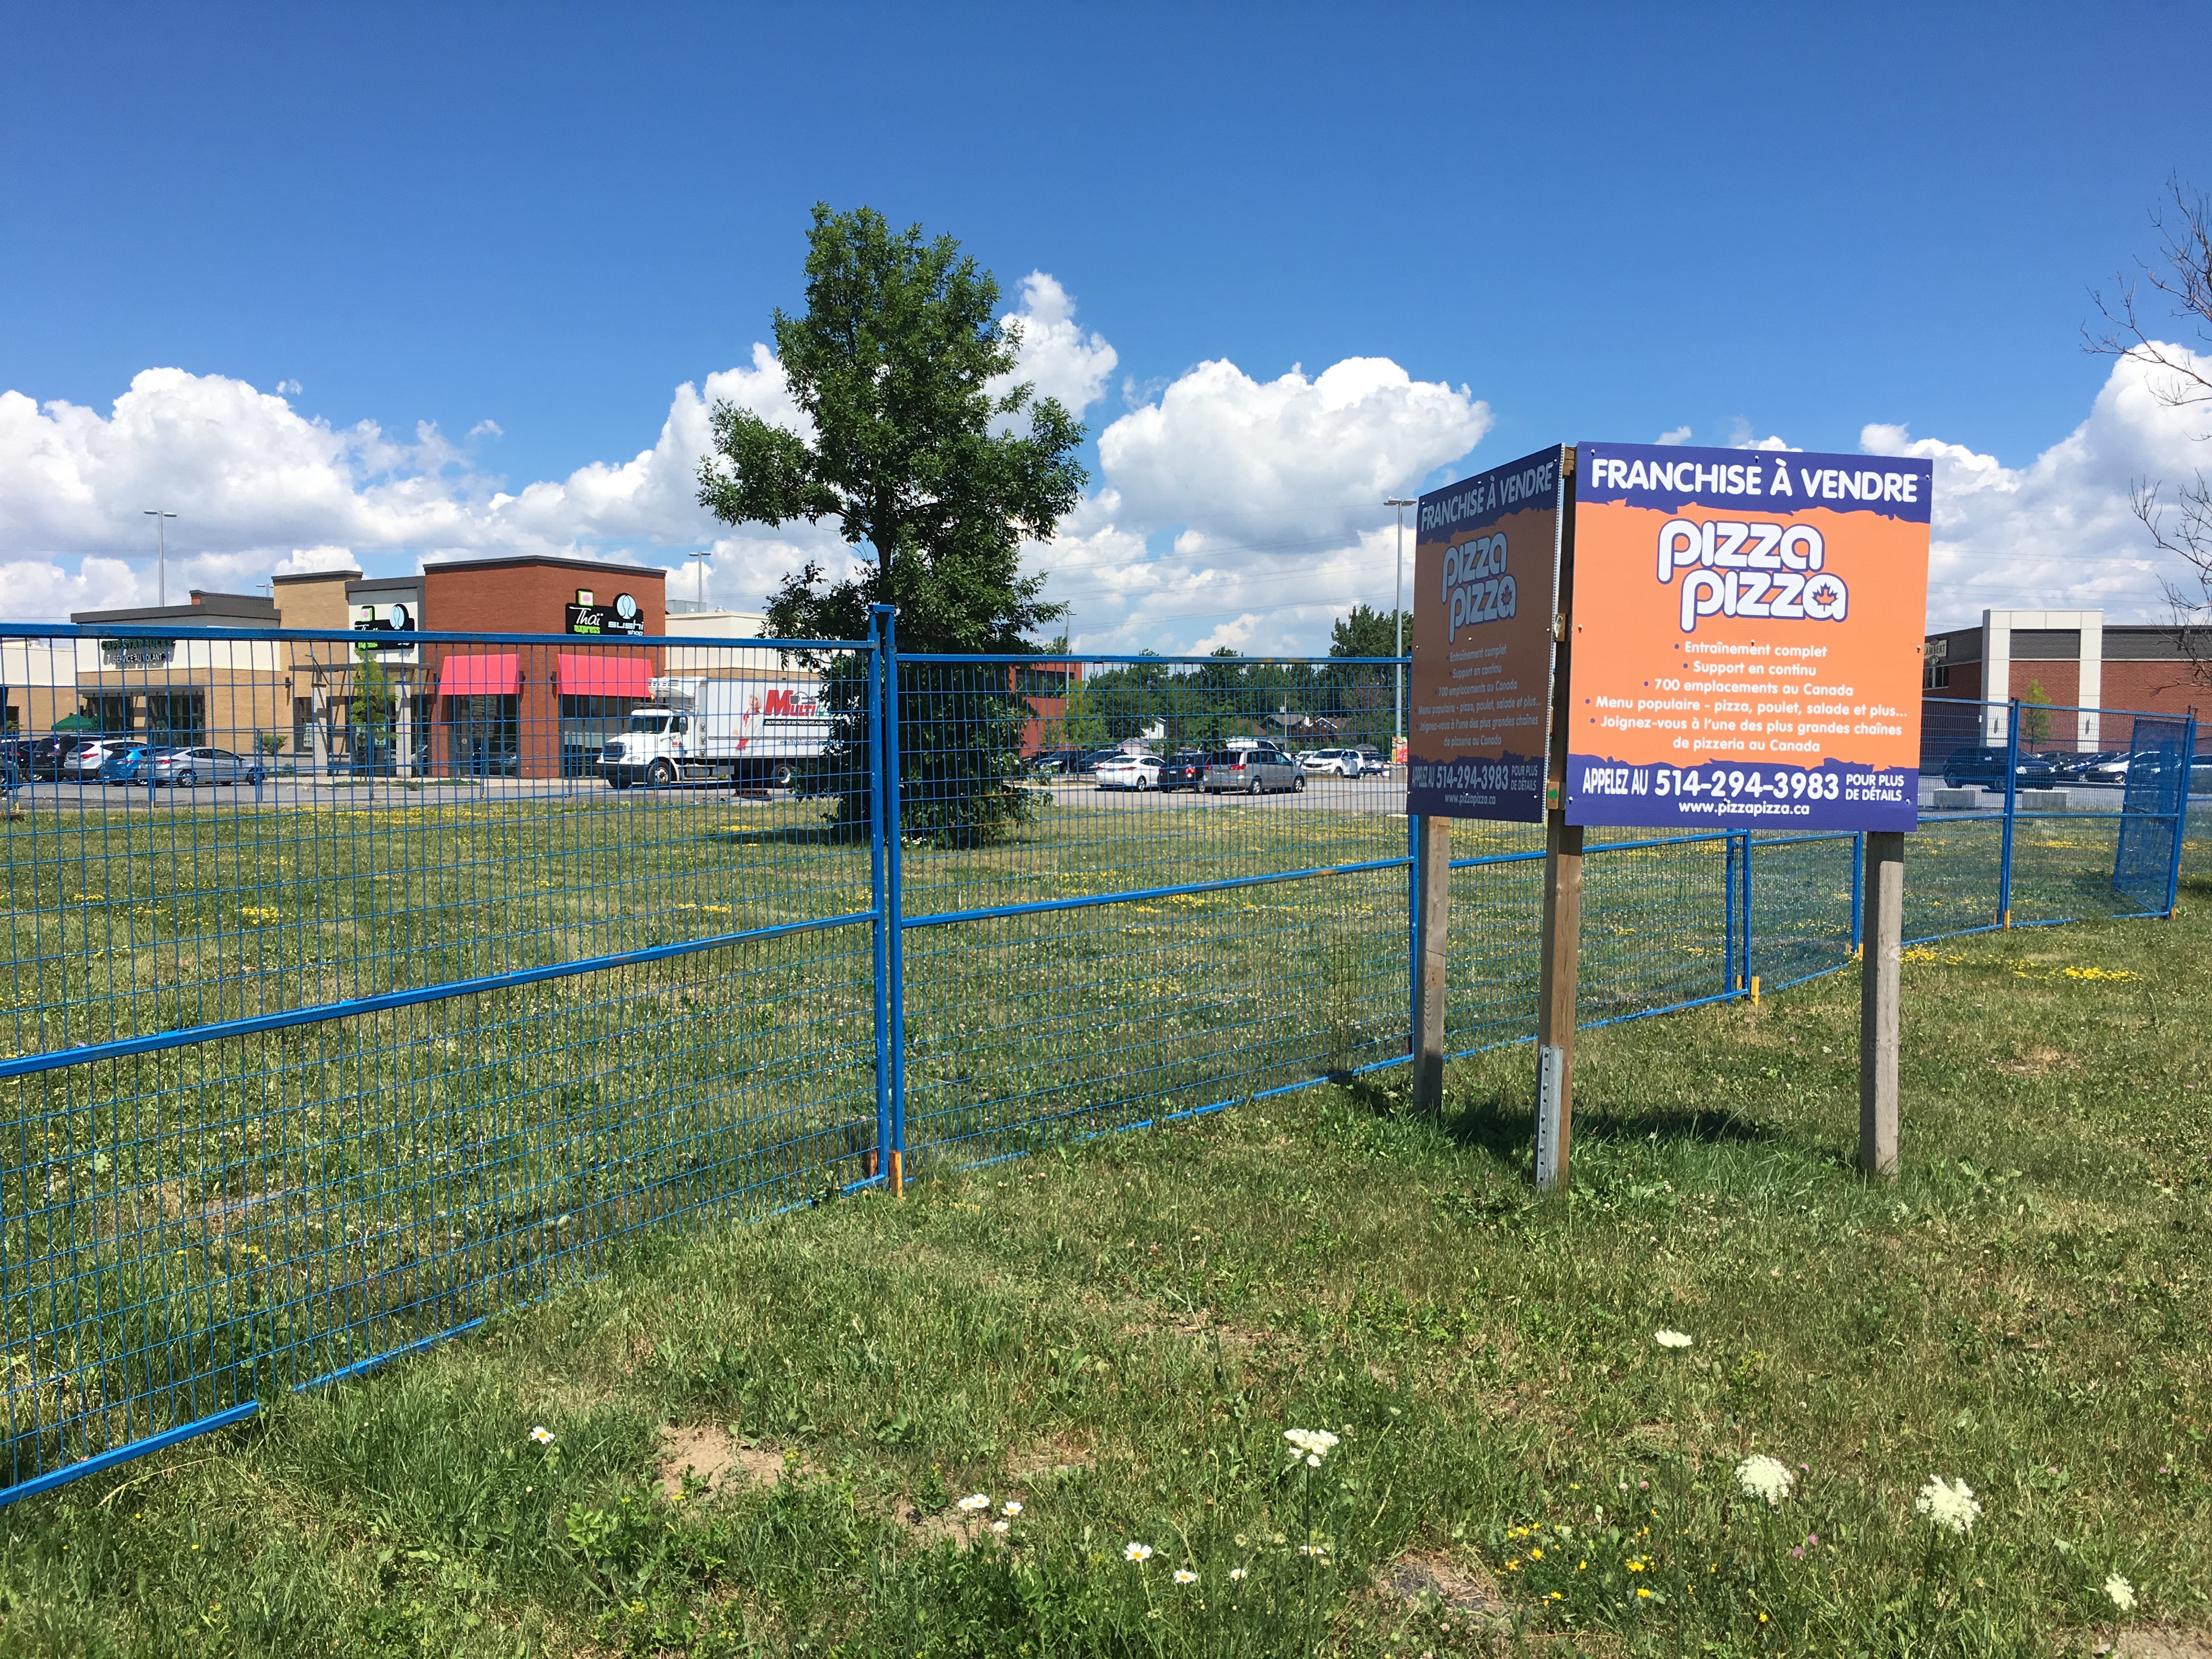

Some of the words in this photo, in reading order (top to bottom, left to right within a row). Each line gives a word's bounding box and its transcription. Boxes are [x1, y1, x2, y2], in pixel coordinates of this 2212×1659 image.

[1592, 459, 1762, 495] FRANCHISE
[1770, 458, 1792, 496] À
[1801, 469, 1918, 503] VENDRE
[1421, 487, 1485, 532] FRANCHISE
[1486, 475, 1496, 510] À
[1500, 462, 1554, 505] VENDRE
[1657, 519, 1825, 583] pizza
[1442, 533, 1507, 603] pizza
[1449, 575, 1516, 644] pizza
[1681, 568, 1848, 633] pizza
[569, 606, 603, 625] Thaï
[608, 619, 644, 630] sushi
[574, 625, 600, 634] express
[1450, 647, 1483, 662] Entraînement
[1485, 644, 1506, 658] complet
[1685, 641, 1771, 656] Entraînement
[1774, 645, 1827, 659] complet
[1924, 645, 1946, 656] AMBERT
[1453, 667, 1472, 680] Support
[1482, 663, 1502, 675] continu
[1693, 661, 1745, 676] Support
[1748, 664, 1764, 674] en
[1769, 663, 1816, 676] continu
[1438, 686, 1448, 697] 700
[1449, 682, 1486, 697] emplacements
[1496, 679, 1517, 691] Canada
[1655, 679, 1680, 691] 700
[1684, 680, 1779, 695] emplacements
[1782, 685, 1799, 695] au
[1803, 683, 1853, 696] Canada
[1418, 706, 1431, 715] Menu
[1460, 701, 1475, 714] pizza,
[1476, 699, 1494, 713] poulet,
[1497, 697, 1515, 709] salade
[1516, 697, 1523, 708] et
[1595, 696, 1633, 708] Menu
[1638, 697, 1700, 713] populaire
[1714, 699, 1753, 714] pizza,
[1757, 701, 1802, 716] poulet,
[1807, 702, 1850, 715] salade
[1854, 704, 1867, 715] et
[1870, 704, 1908, 719] plus...
[1419, 721, 1449, 733] Joignez-vous
[1470, 718, 1478, 728] des
[1480, 717, 1491, 730] plus
[1492, 716, 1514, 730] grandes
[1516, 714, 1538, 726] chaînes
[1601, 715, 1688, 731] Joignez-vous
[1691, 716, 1700, 730] à
[1704, 718, 1736, 731] l'une
[1740, 719, 1763, 732] des
[1767, 720, 1793, 735] plus
[1797, 721, 1850, 736] grandes
[1854, 722, 1902, 736] chaînes
[1444, 737, 1450, 747] de
[1451, 736, 1471, 748] pizzeria
[1480, 734, 1501, 746] Canada
[1673, 736, 1689, 748] de
[1694, 737, 1744, 752] pizzeria
[1749, 741, 1765, 751] au
[1770, 739, 1820, 752] Canada
[1412, 766, 1427, 788] APPELEZ
[1428, 766, 1435, 788] AU
[1436, 765, 1508, 791] 514-294-3983
[1511, 765, 1525, 776] POUR
[1526, 765, 1538, 776] PLUS
[1510, 780, 1517, 791] DE
[1518, 777, 1537, 791] DÉTAILS
[1582, 767, 1628, 795] APPELEZ
[1631, 768, 1649, 795] AU
[1654, 769, 1839, 800] 514-294-3983
[1846, 774, 1876, 786] POUR
[1878, 775, 1904, 787] PLUS
[1444, 792, 1496, 806] www.pizzapizza.ca
[1845, 788, 1859, 800] DE
[1862, 786, 1902, 802] DÉTAILS
[1678, 798, 1810, 817] www.pizzapizza.ca
